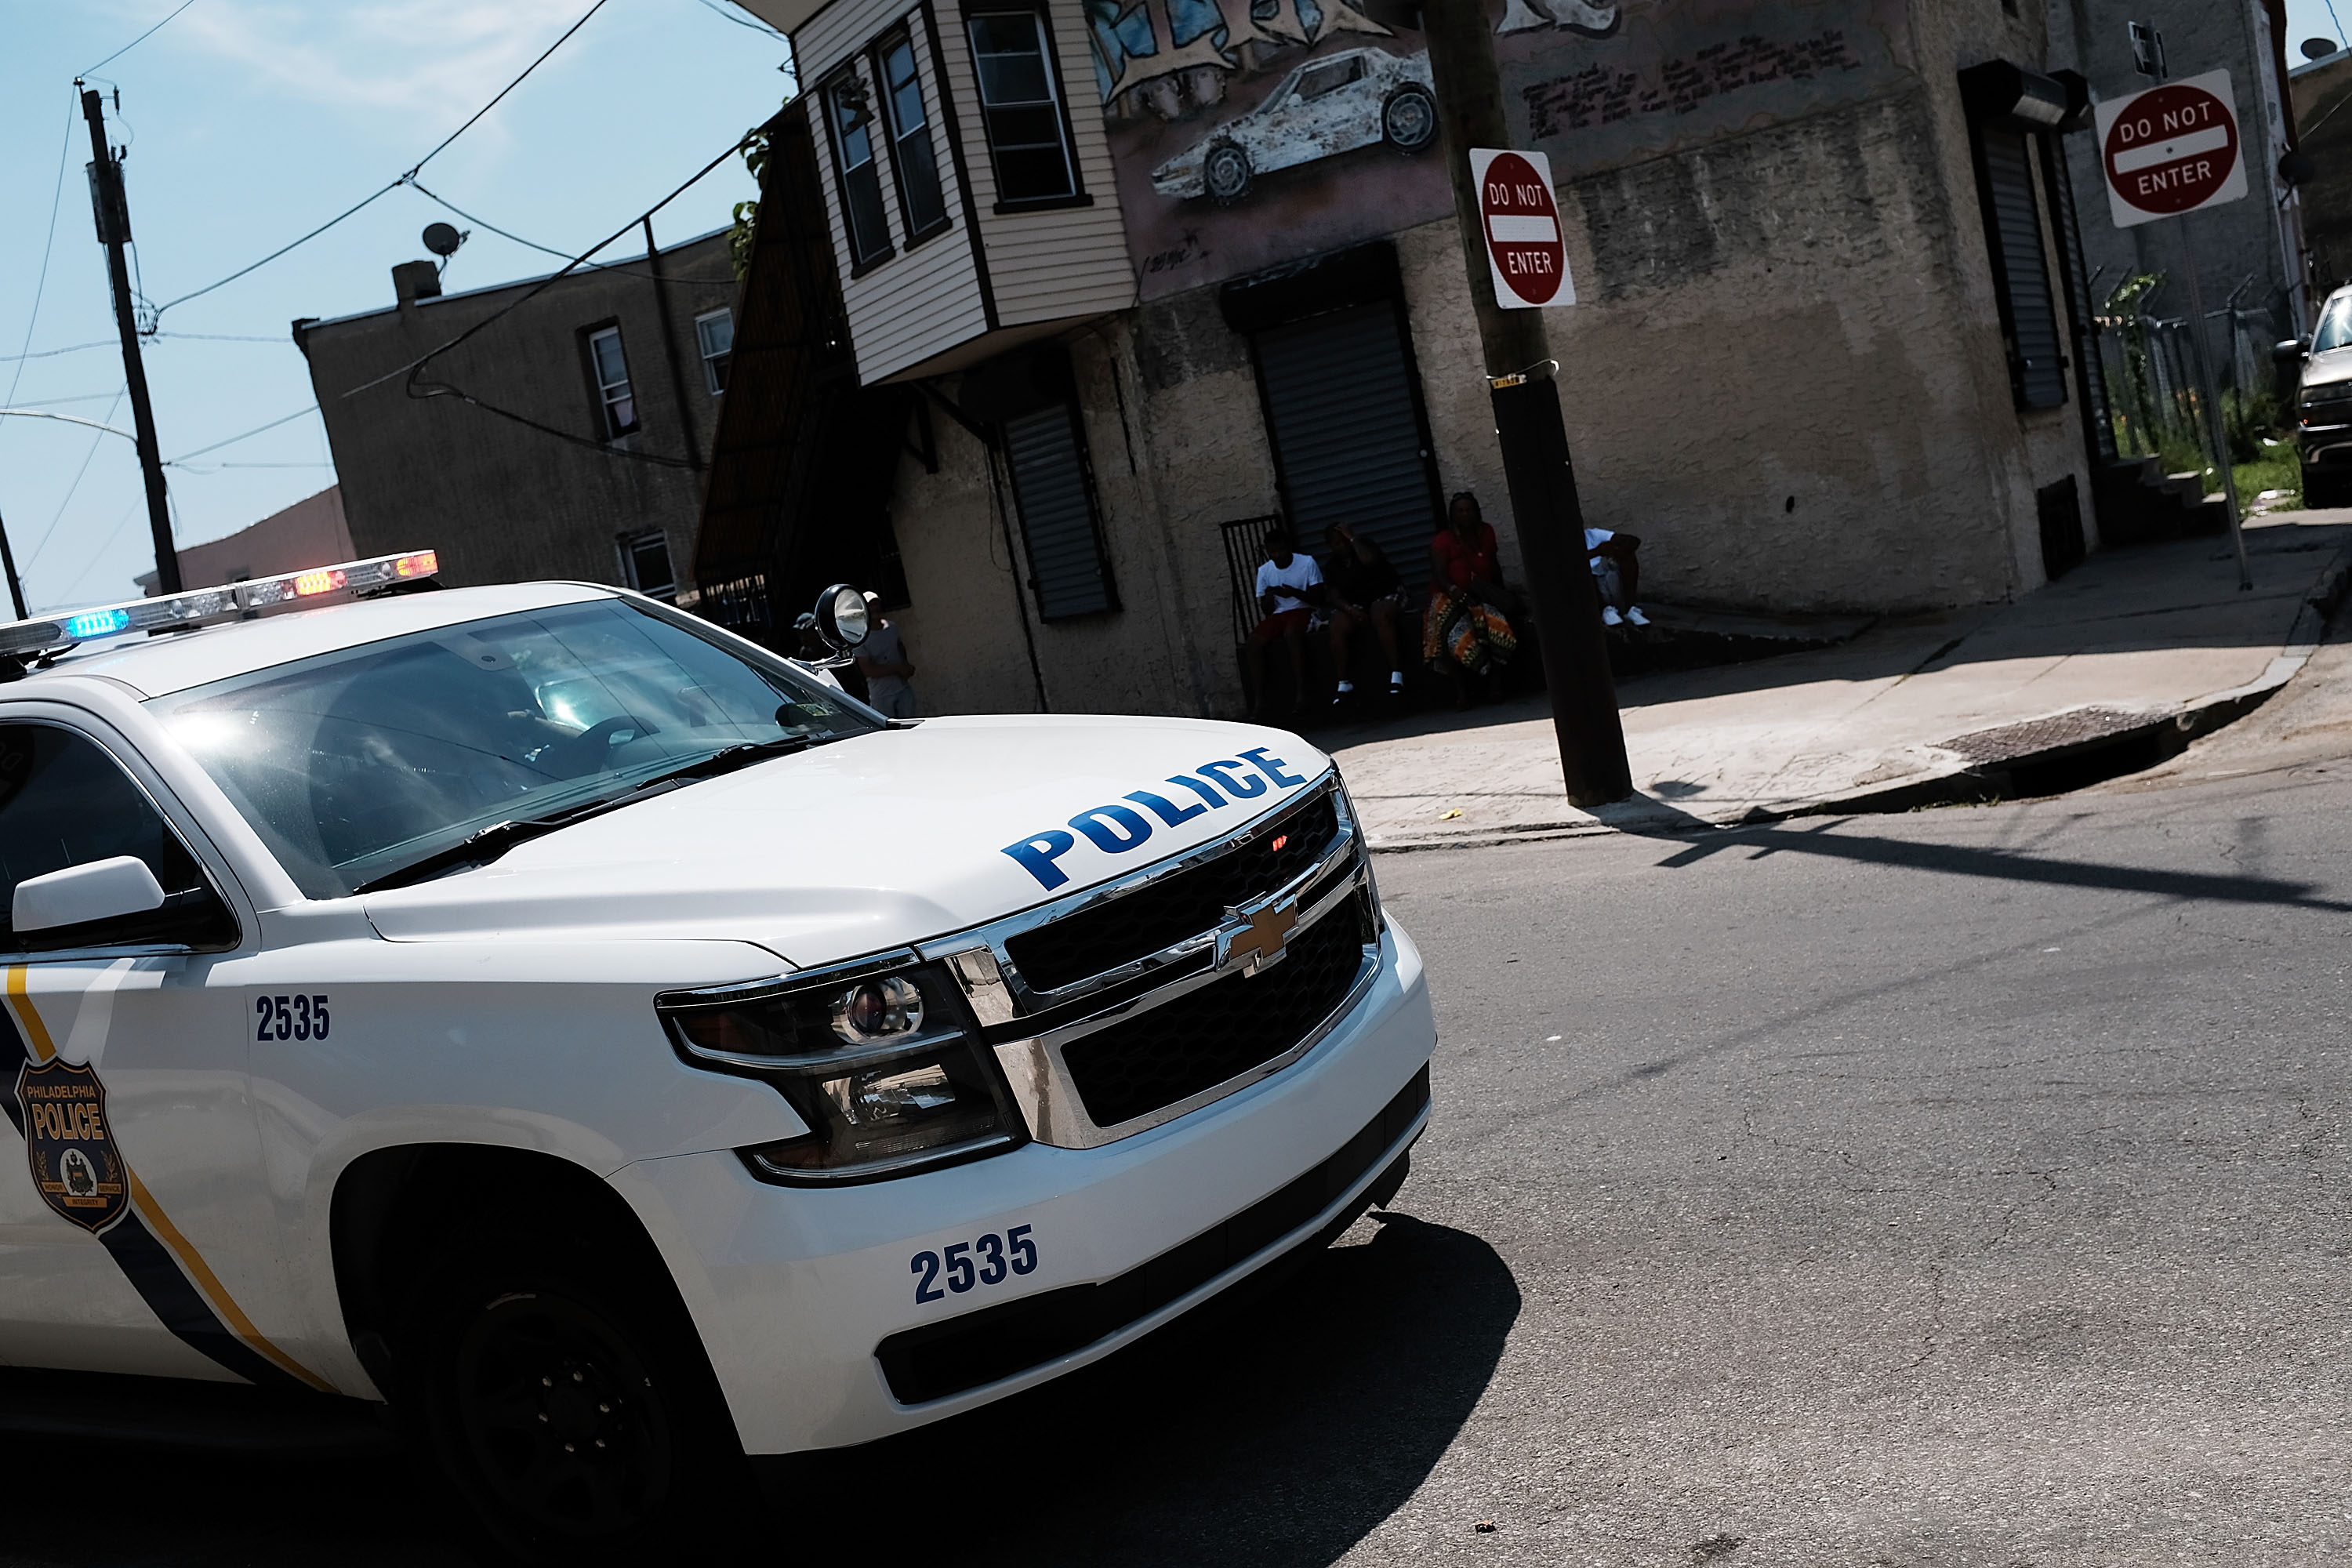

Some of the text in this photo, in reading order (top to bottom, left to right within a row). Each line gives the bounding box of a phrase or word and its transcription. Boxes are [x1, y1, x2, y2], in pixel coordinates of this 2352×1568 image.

[2120, 102, 2212, 143] DO NOT
[1488, 183, 1543, 207] DO NOT
[2137, 161, 2212, 195] ENTER
[1507, 252, 1554, 274] ENTER
[1000, 746, 1308, 892] POLICE
[256, 994, 330, 1042] 2535
[27, 1085, 96, 1098] PHILADELPHIA
[31, 1103, 104, 1140] POLICE
[909, 1223, 1038, 1305] 2535
